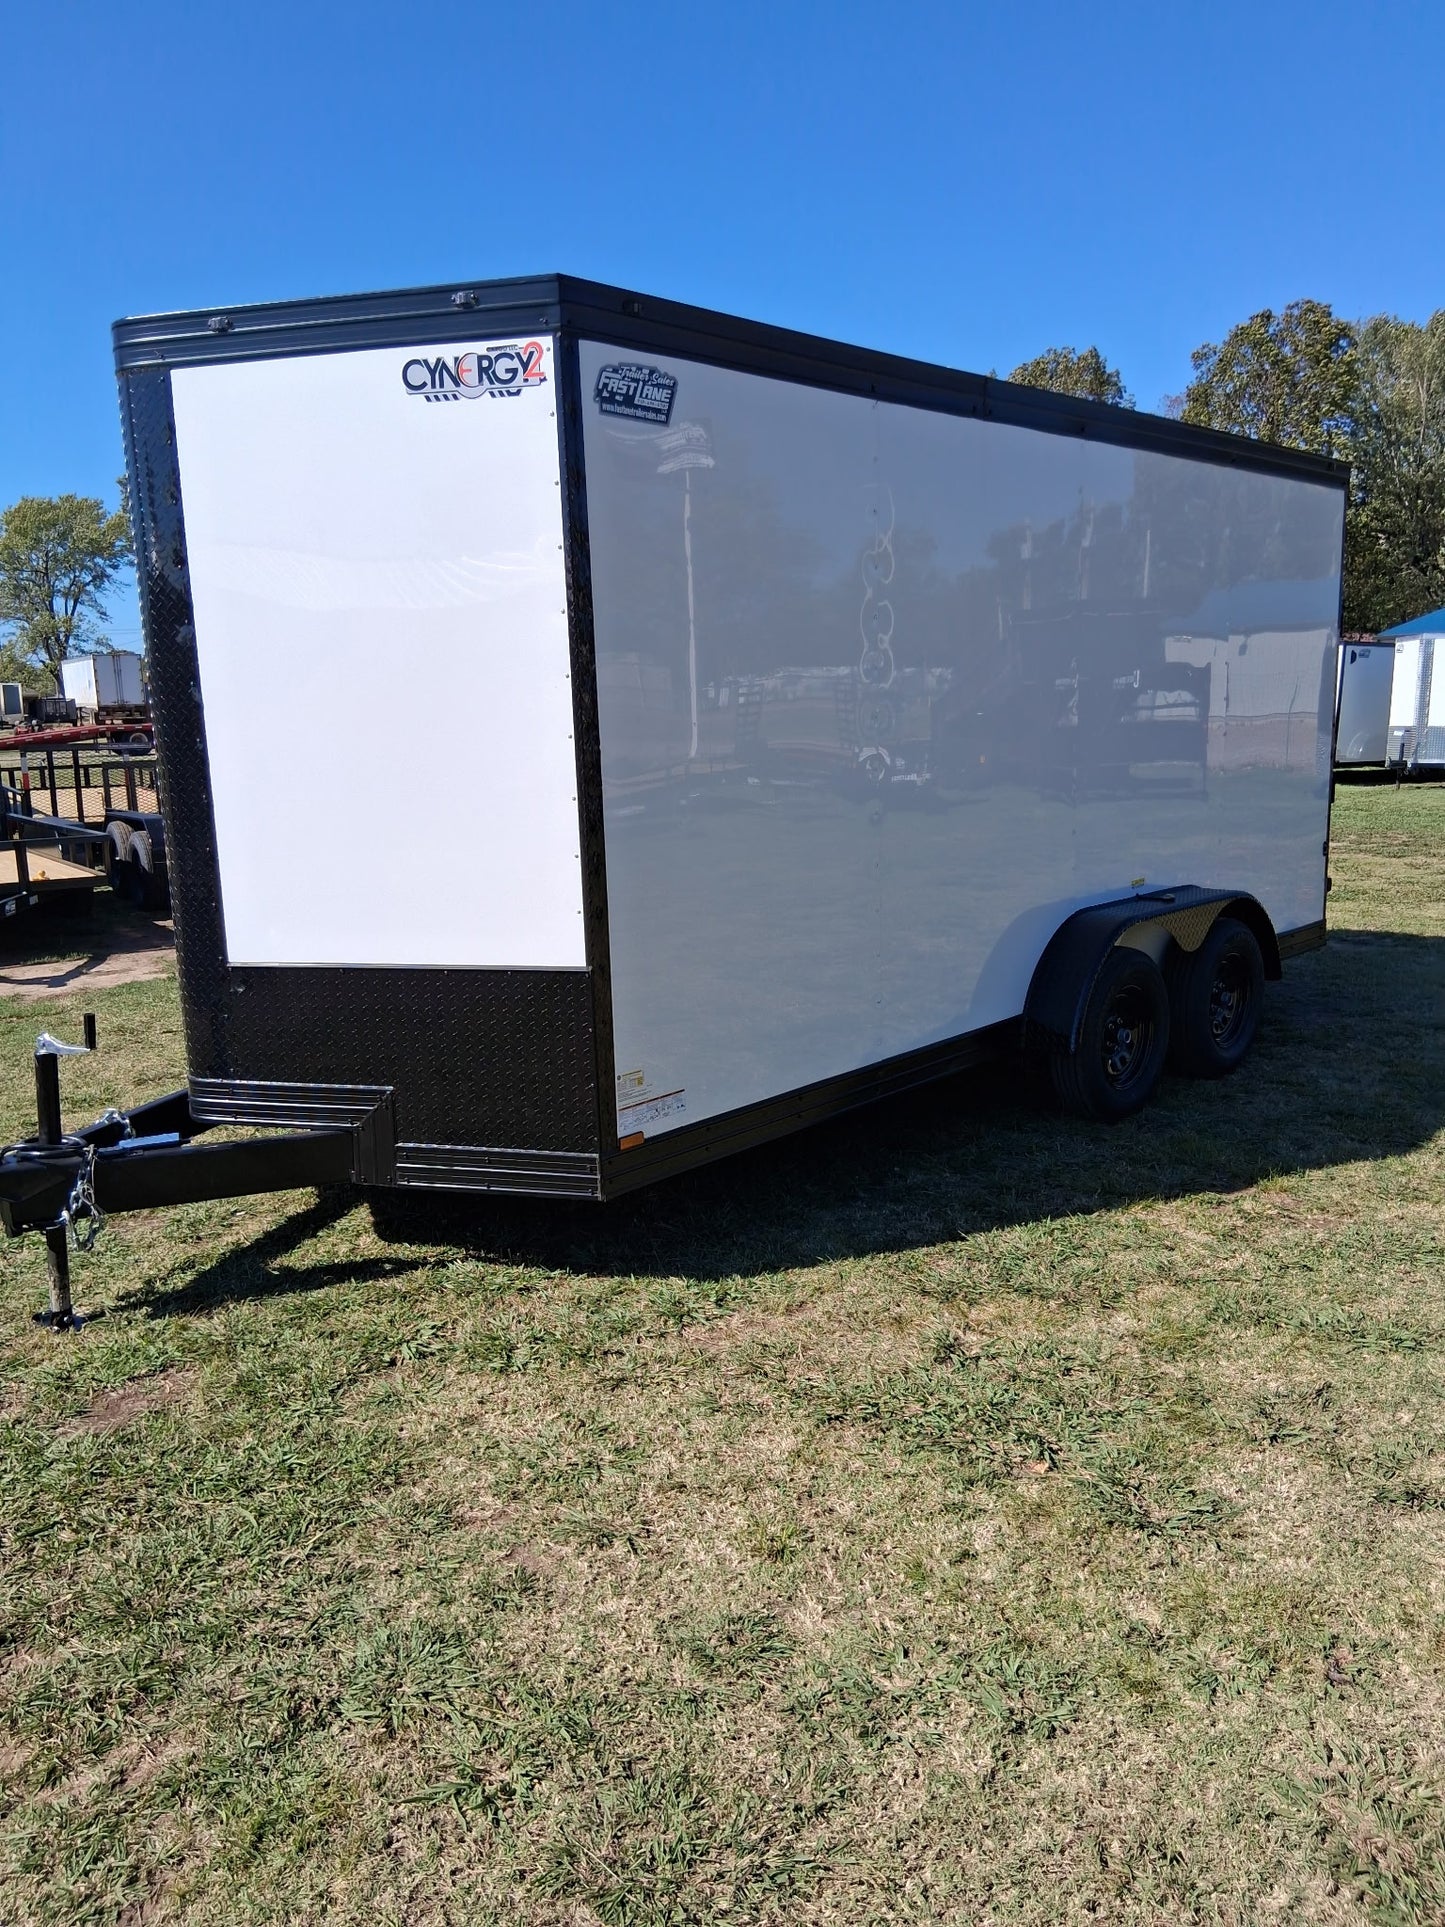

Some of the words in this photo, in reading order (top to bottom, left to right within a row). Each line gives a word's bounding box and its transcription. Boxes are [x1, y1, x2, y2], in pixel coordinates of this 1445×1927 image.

[598, 371, 638, 396] FAST
[634, 381, 672, 409] LANE
[620, 366, 649, 381] Trailer
[648, 372, 675, 387] Sales
